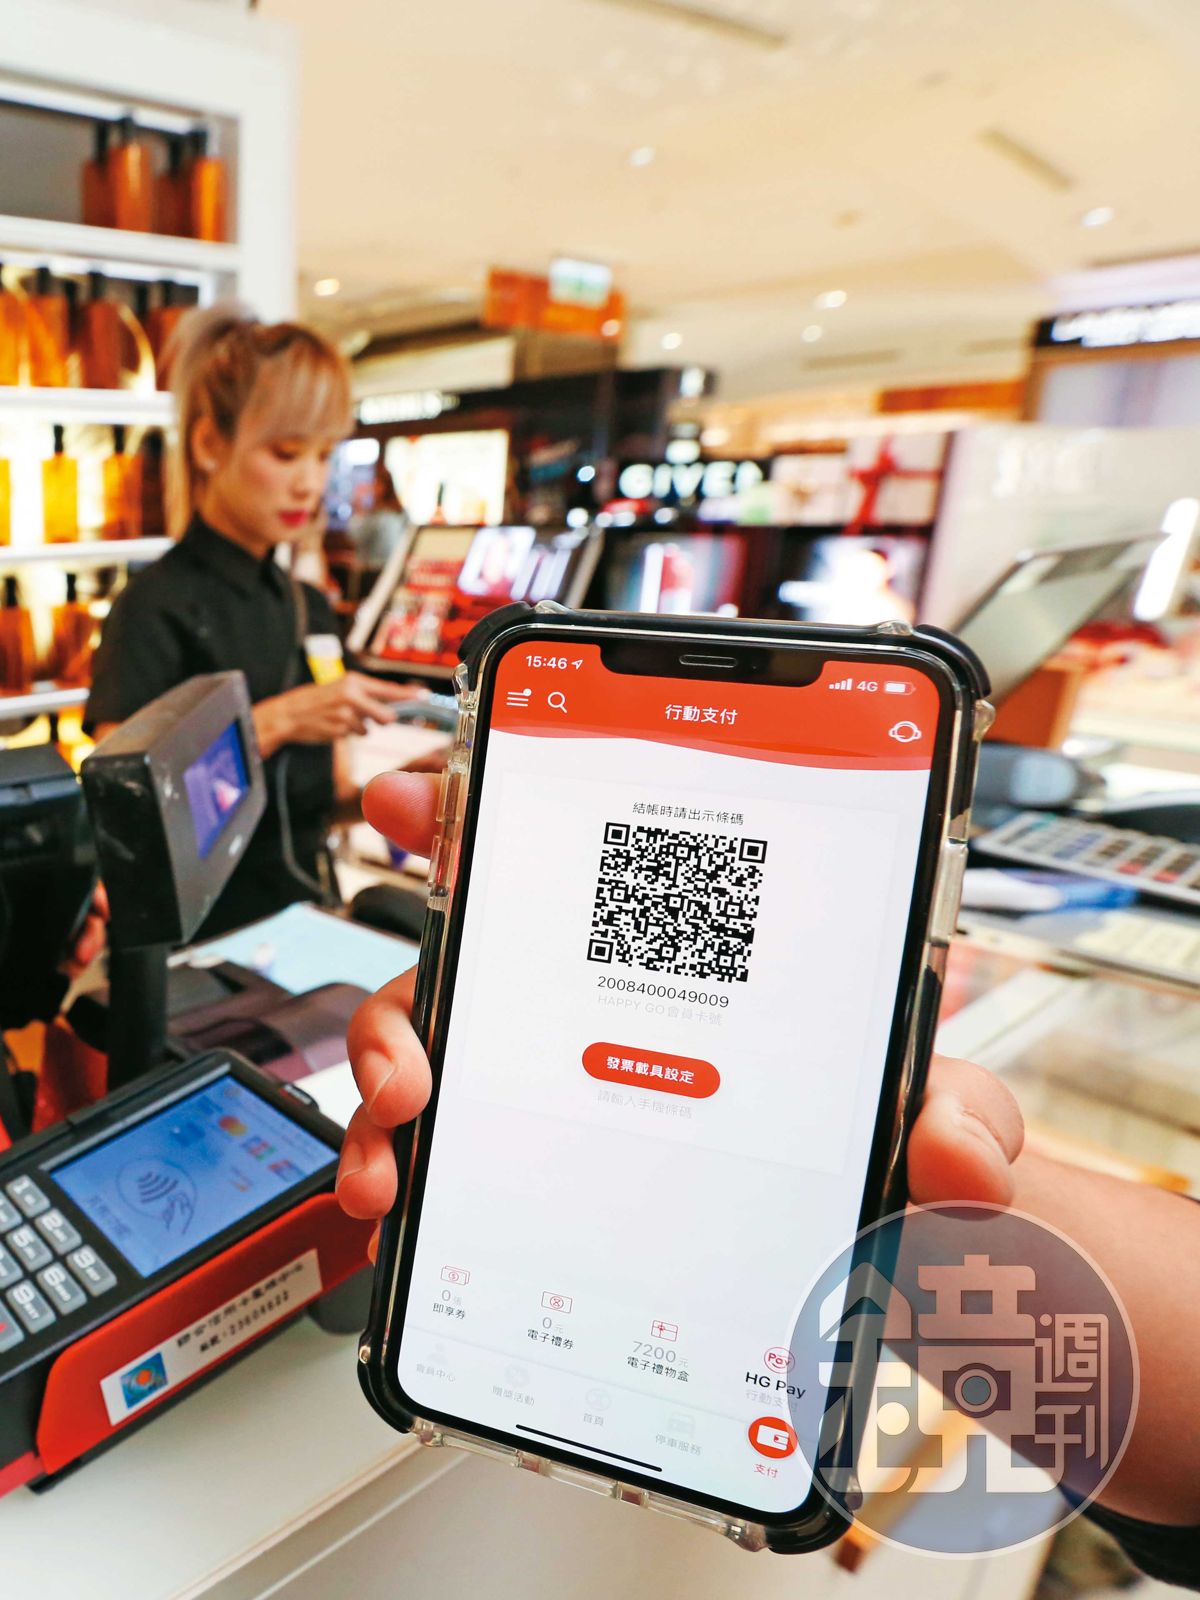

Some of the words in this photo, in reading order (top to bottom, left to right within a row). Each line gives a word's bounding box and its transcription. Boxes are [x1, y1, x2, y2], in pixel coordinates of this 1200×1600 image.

[525, 655, 568, 671] 15:46
[857, 680, 878, 693] 4G
[665, 703, 738, 726] 行動支付
[632, 801, 745, 826] 結帳時請出示條碼
[597, 975, 729, 1008] 2008400049009
[598, 995, 641, 1012] HAPPY
[606, 1056, 695, 1085] 發票載具設定
[13, 1180, 29, 1194] 1
[42, 1214, 62, 1231] 2
[13, 1229, 33, 1247] 5
[73, 1251, 95, 1269] 3
[44, 1268, 65, 1286] 6
[13, 1284, 35, 1303] 9
[441, 1289, 451, 1302] 0
[432, 1302, 466, 1320] 即享券
[542, 1316, 552, 1330] 0
[527, 1328, 574, 1350] 電子禮券
[632, 1340, 676, 1363] 7200
[627, 1356, 690, 1383] 電子禮物盒
[745, 1371, 771, 1388] HG
[775, 1380, 806, 1400] Pay
[754, 1463, 779, 1479] 支付
